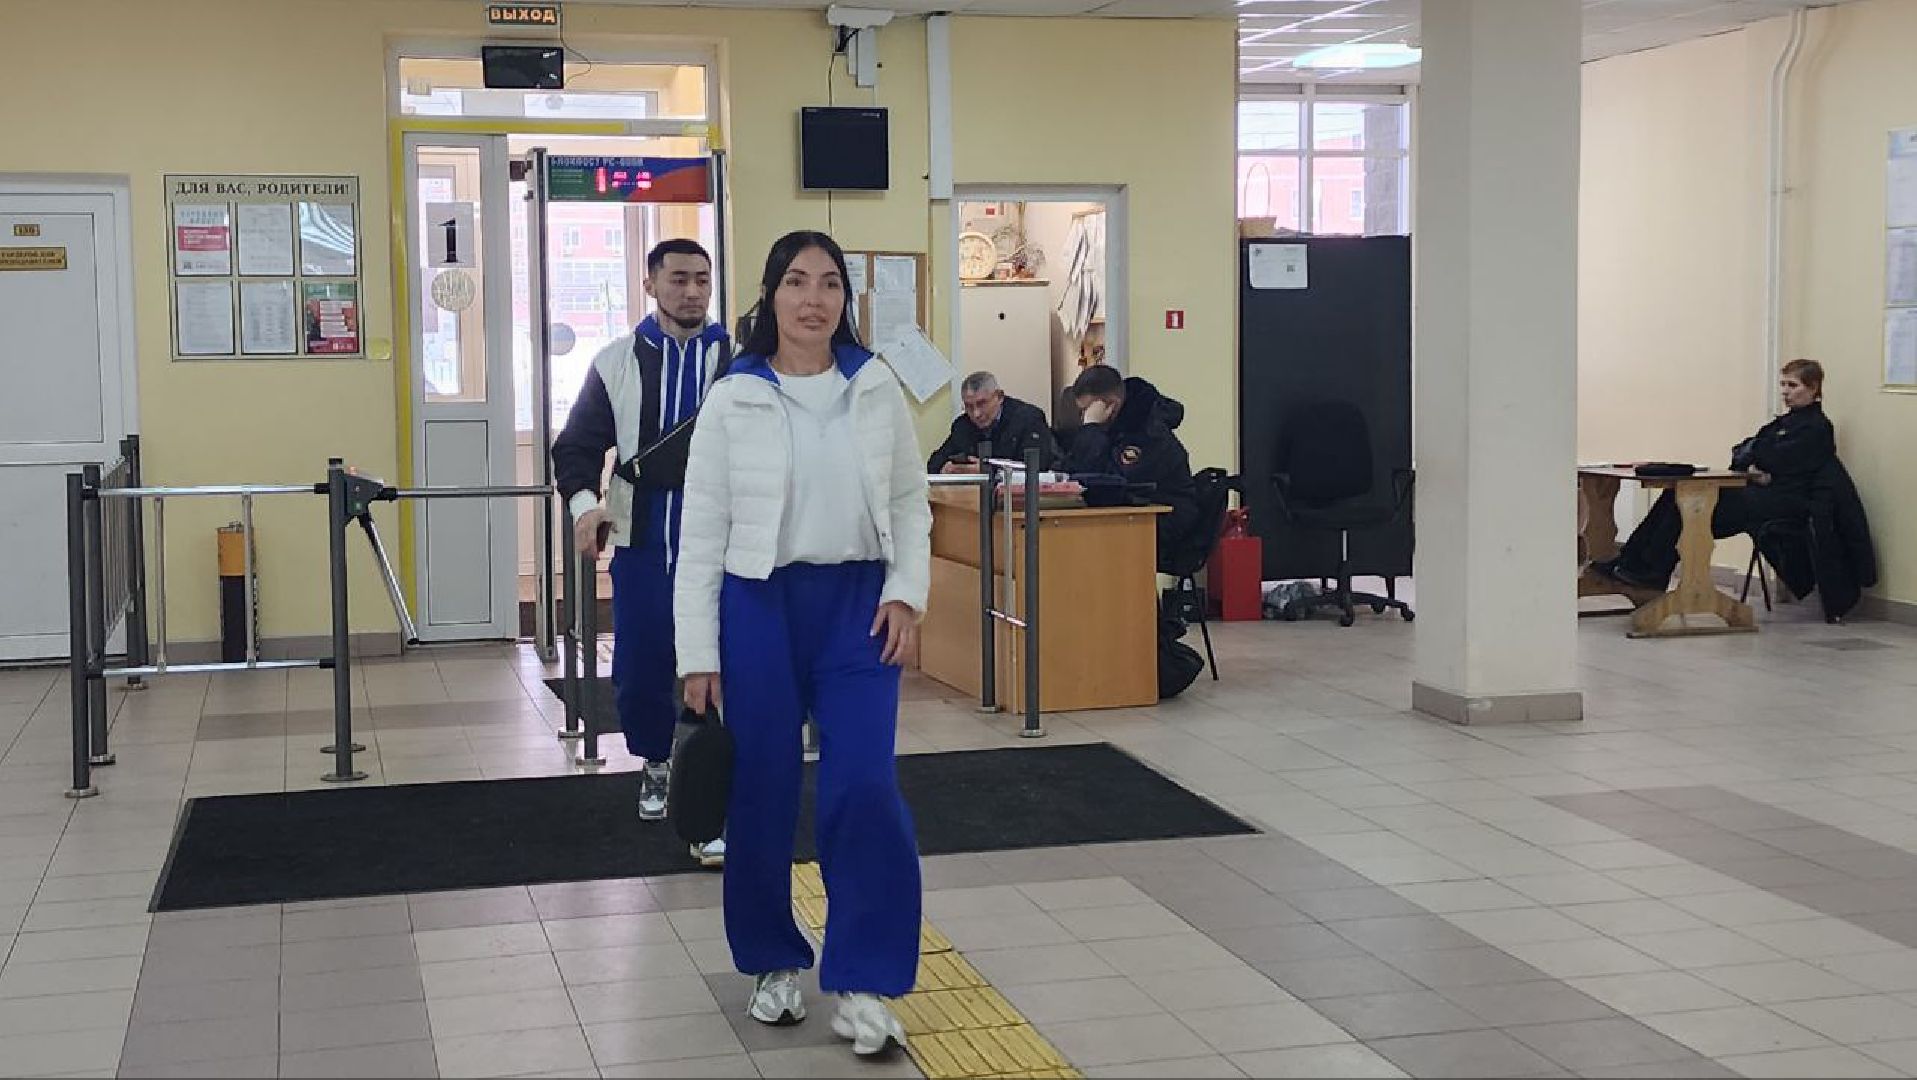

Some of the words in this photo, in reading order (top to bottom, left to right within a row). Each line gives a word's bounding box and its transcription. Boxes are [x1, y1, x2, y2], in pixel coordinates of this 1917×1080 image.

[490, 8, 555, 23] ВЫХОД
[175, 181, 209, 195] ДЛЯ
[216, 182, 251, 197] ВАС,
[257, 182, 349, 196] РОДИТЕЛИ!
[438, 217, 464, 263] 1
